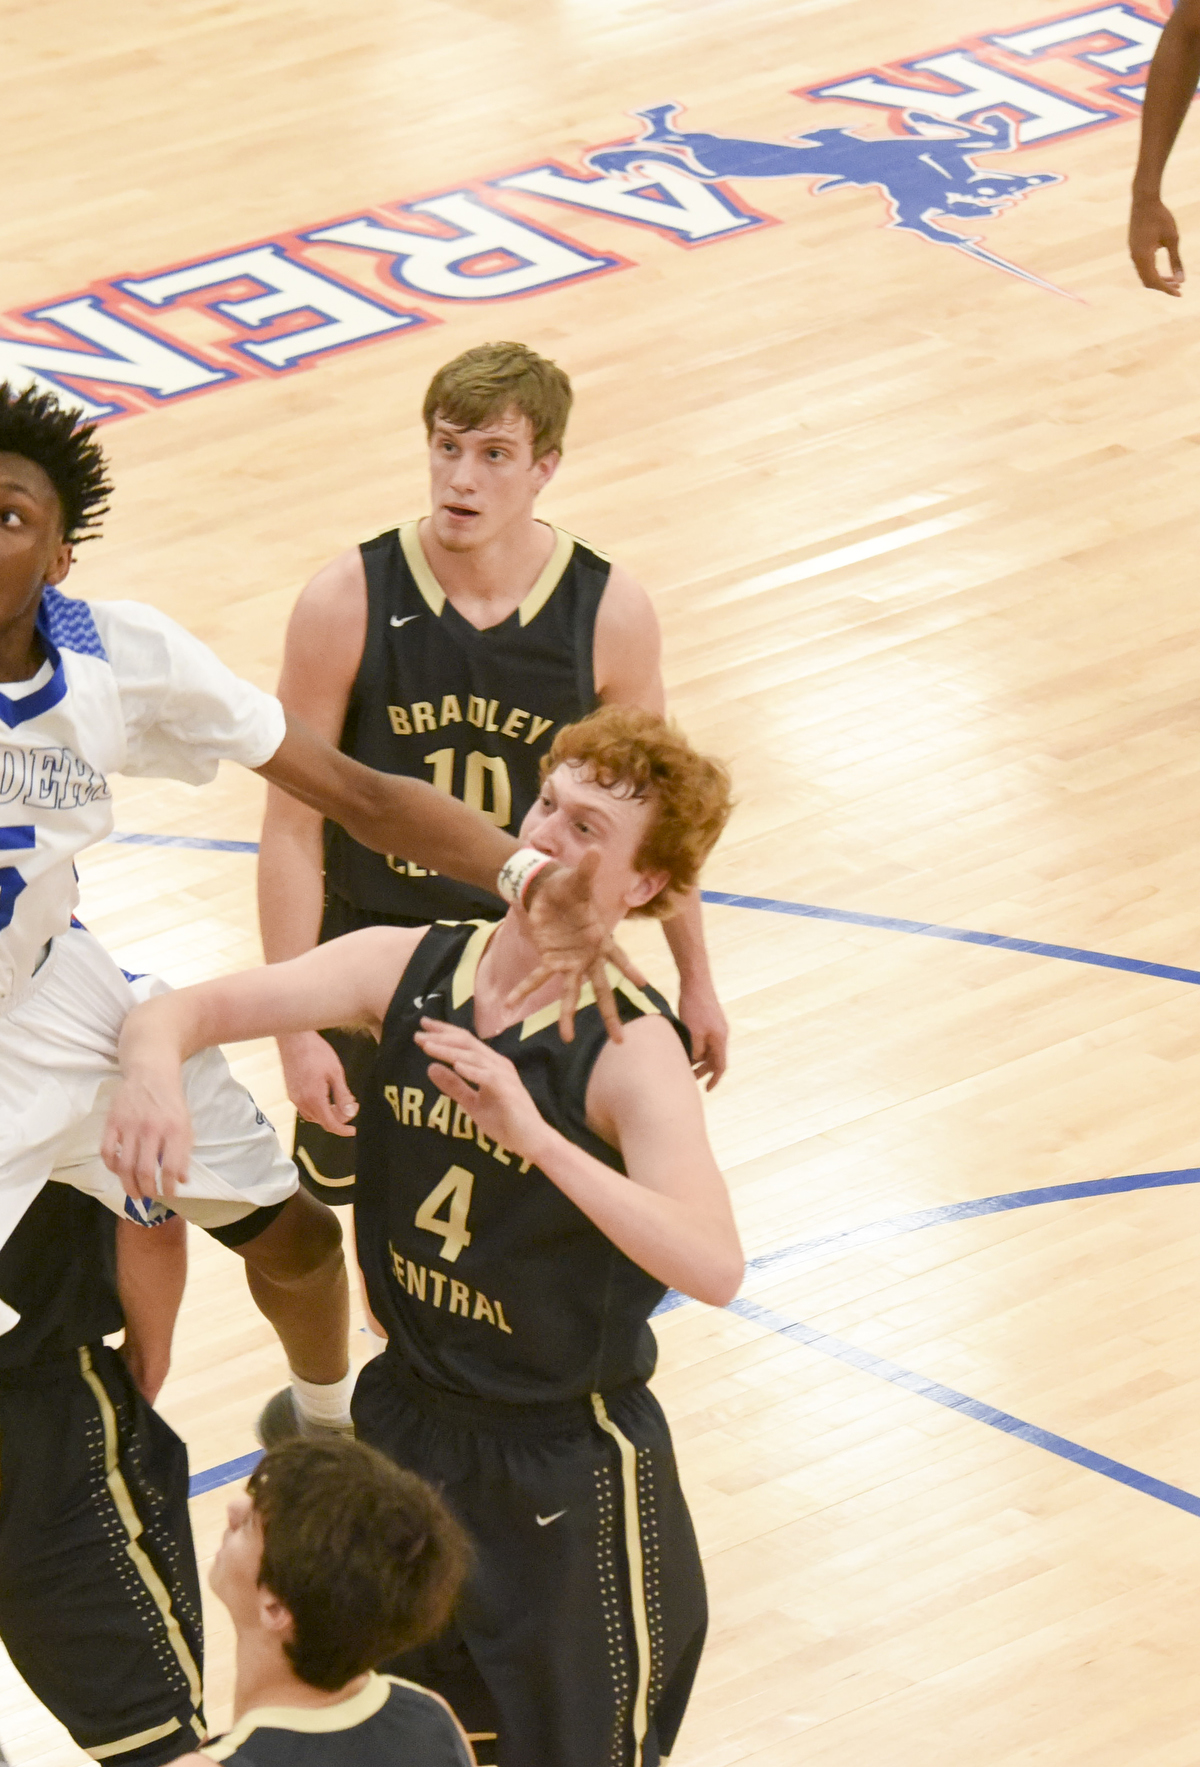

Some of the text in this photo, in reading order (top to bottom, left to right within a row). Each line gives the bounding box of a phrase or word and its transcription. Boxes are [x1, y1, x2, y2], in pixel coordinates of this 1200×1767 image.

[387, 694, 554, 745] BRADLEY
[424, 747, 512, 828] 10
[414, 1164, 475, 1263] 4
[388, 1239, 513, 1334] ENTRAL
